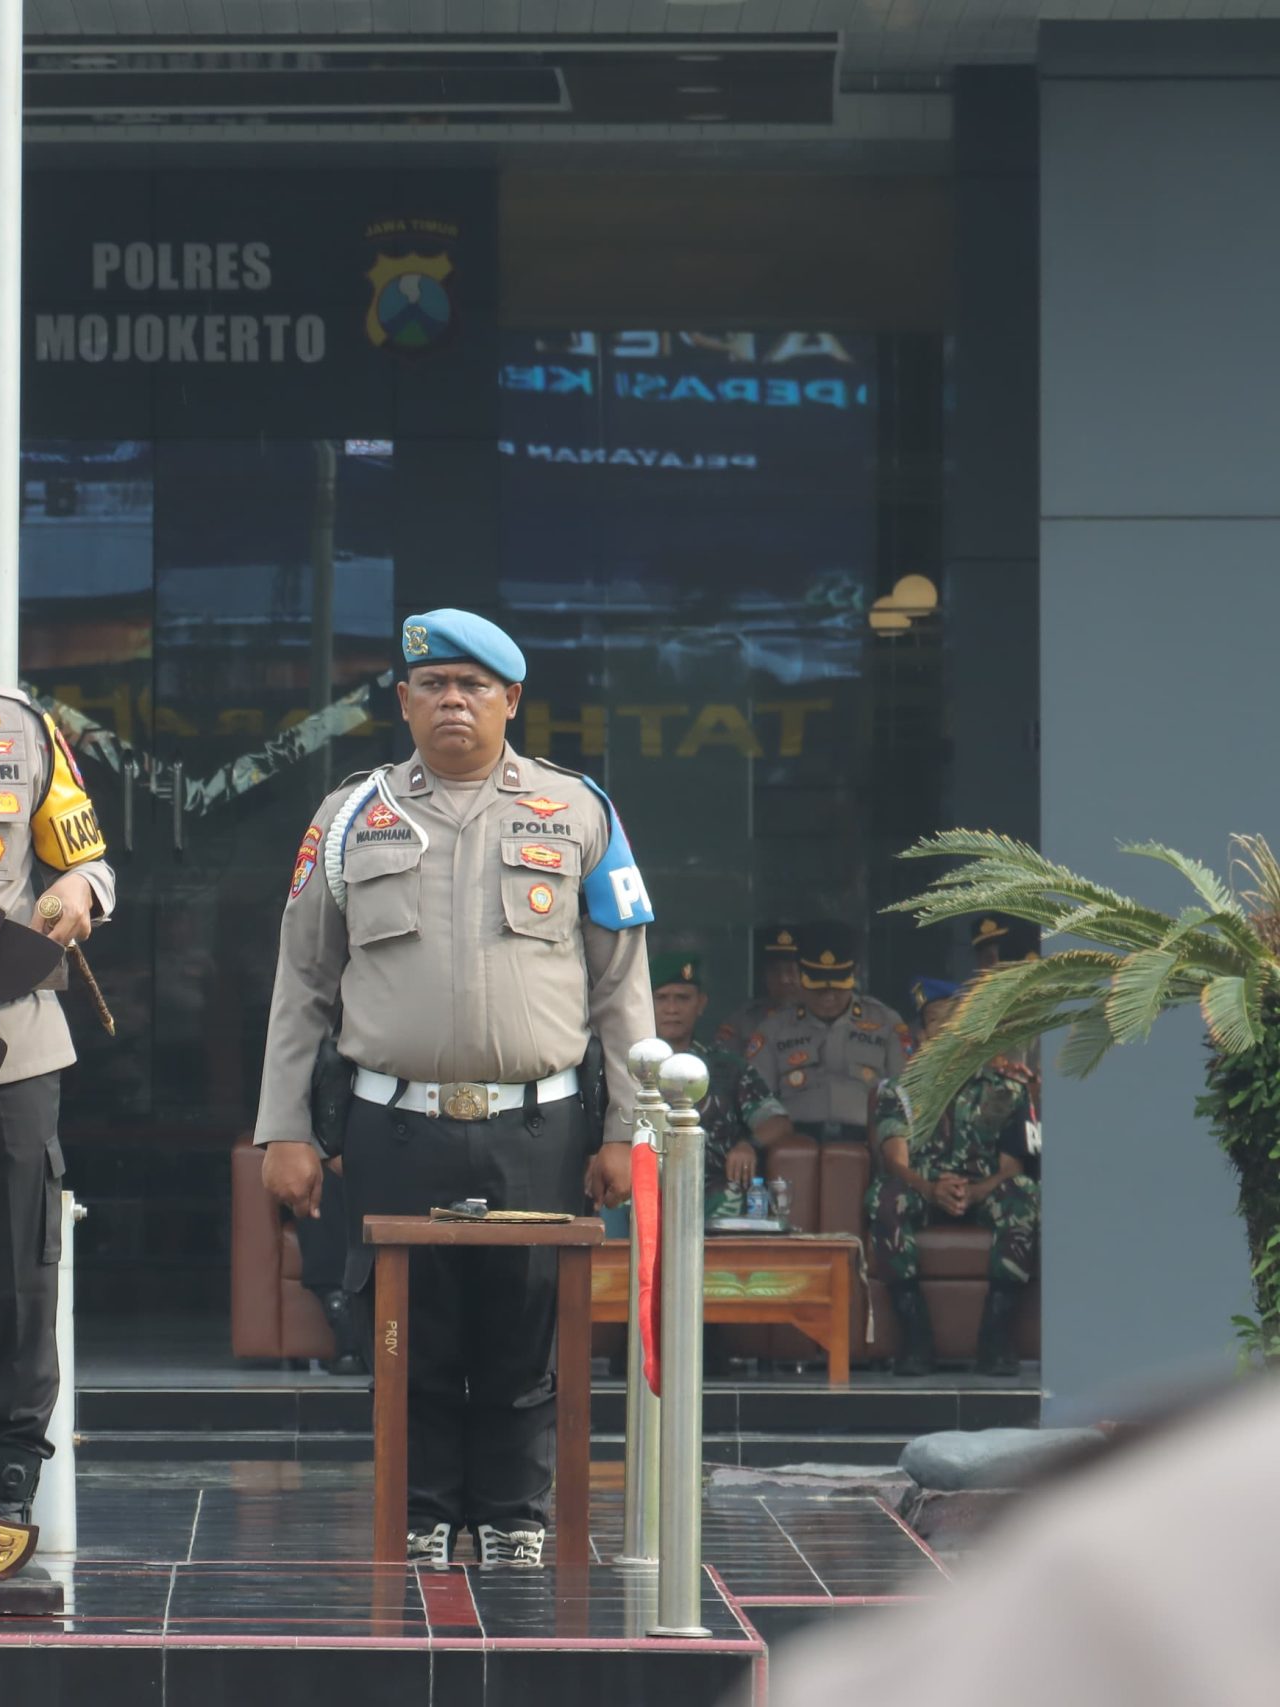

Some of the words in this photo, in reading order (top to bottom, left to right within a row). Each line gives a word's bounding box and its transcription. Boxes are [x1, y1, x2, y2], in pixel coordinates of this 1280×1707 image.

[92, 242, 271, 291] POLRES
[35, 314, 326, 363] MOJOKERTO
[356, 829, 412, 844] WARDHANA
[511, 821, 572, 837] POLRI
[385, 1320, 399, 1356] PROV
